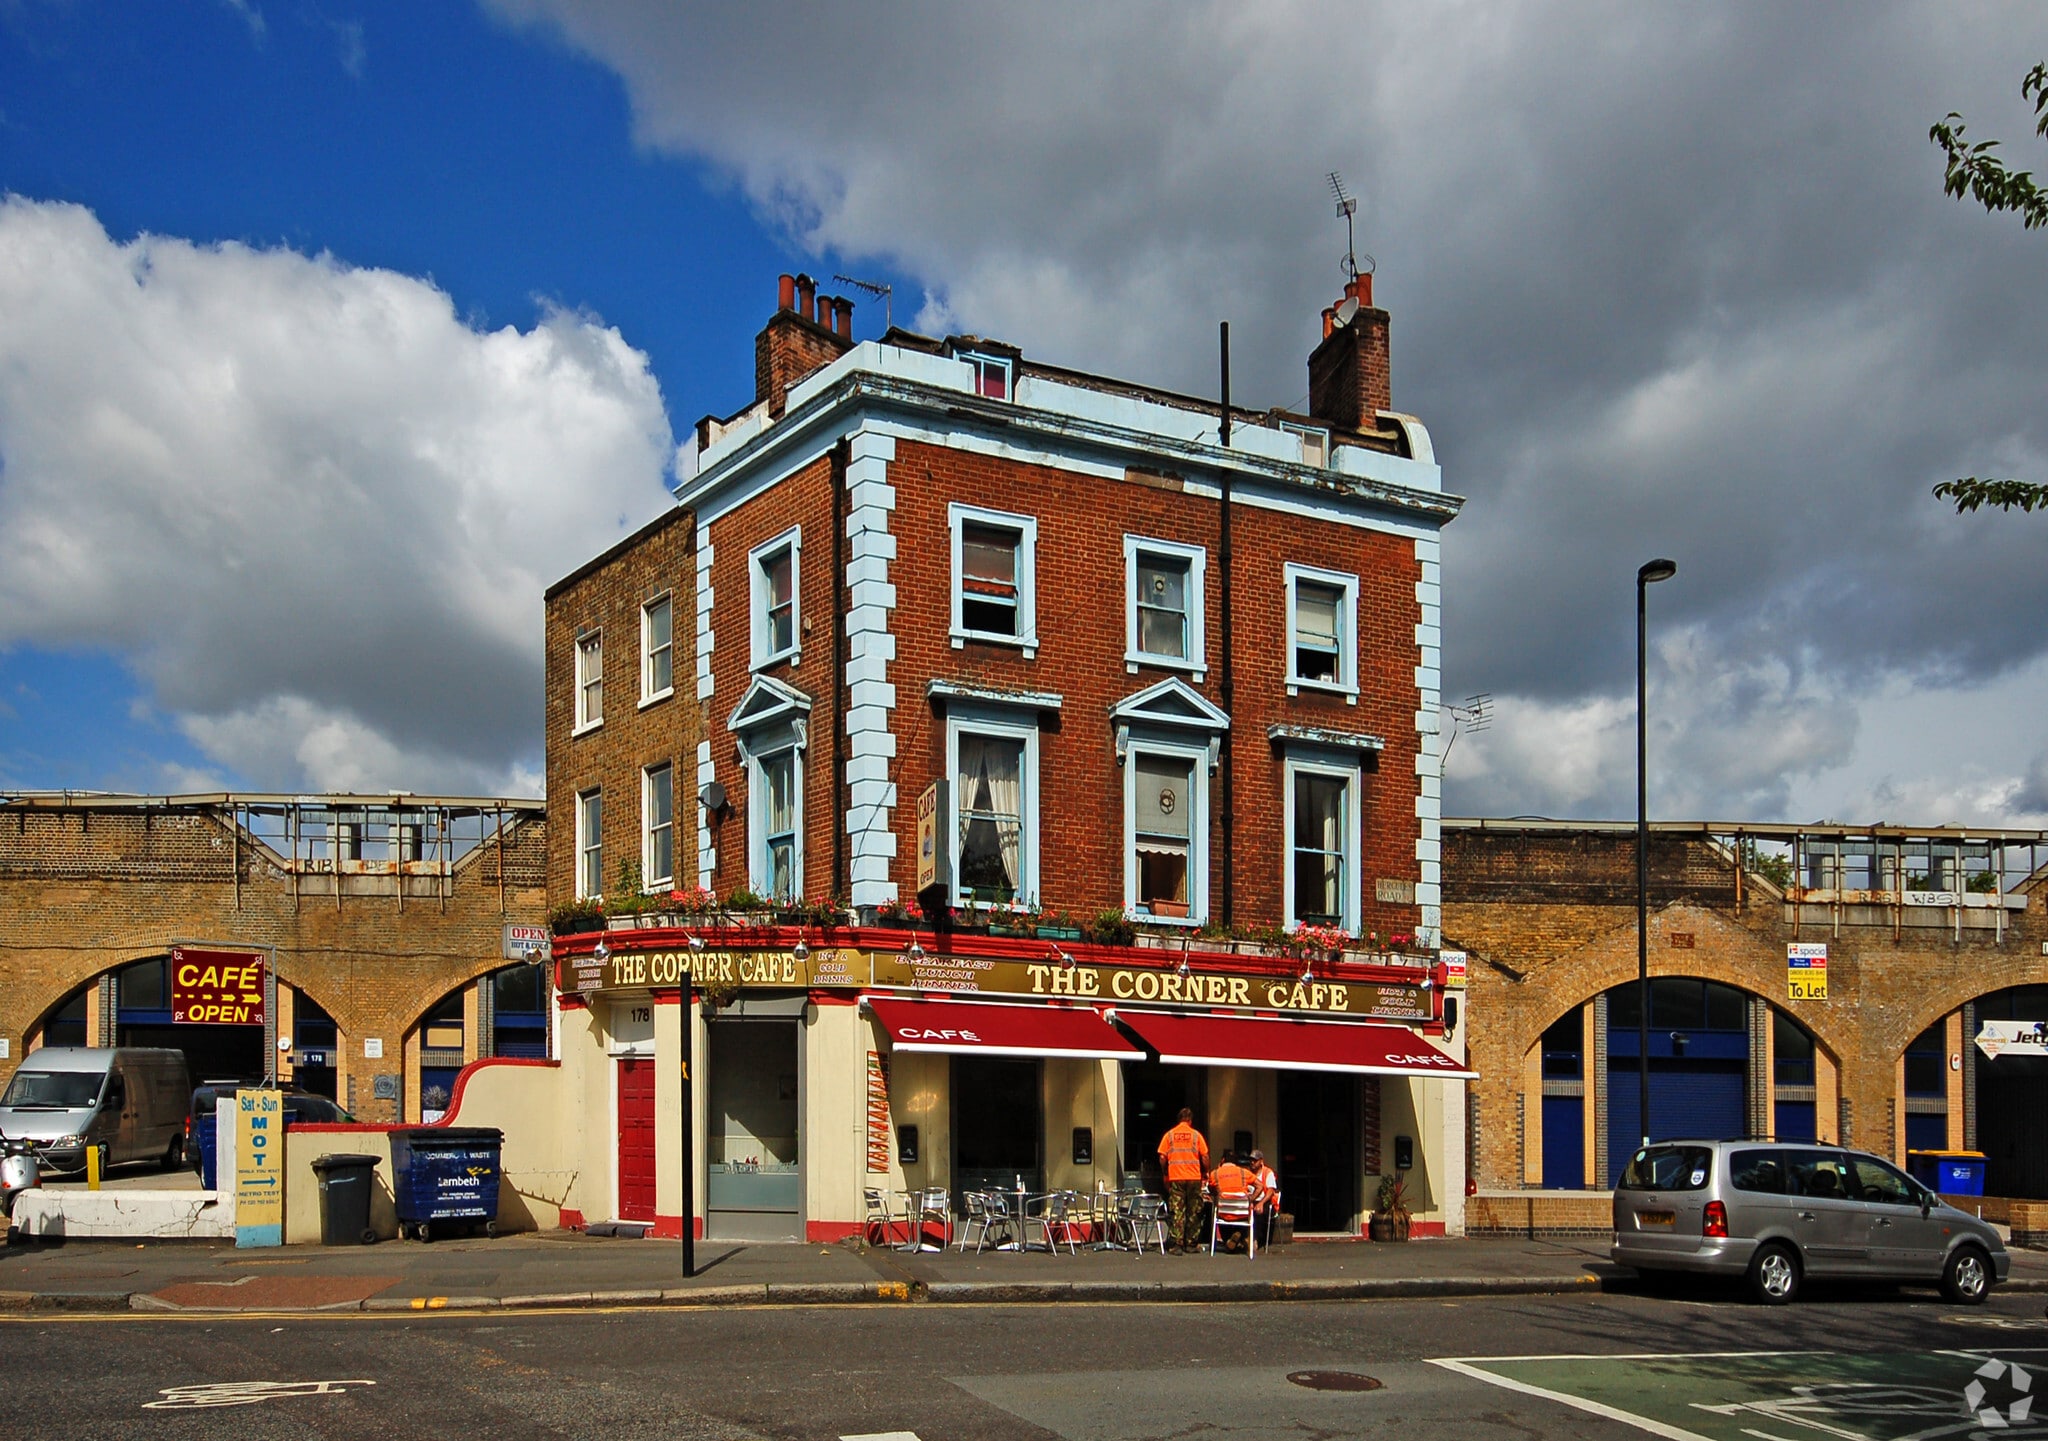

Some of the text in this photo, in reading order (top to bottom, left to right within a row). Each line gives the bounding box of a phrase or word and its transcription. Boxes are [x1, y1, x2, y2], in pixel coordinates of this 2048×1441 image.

[1377, 890, 1402, 900] ROAD
[511, 927, 546, 940] OPEN
[511, 941, 524, 949] HOT
[817, 951, 848, 962] HOT &
[1440, 954, 1465, 964] pacia
[612, 952, 797, 984] THE CORNER CAFE
[819, 962, 847, 973] COLD
[178, 961, 259, 990] CAFÉ
[813, 974, 853, 984] DRINKS
[915, 968, 975, 980] LUNCH
[1026, 964, 1349, 1012] THE CORNER CAFE
[1789, 982, 1826, 998] To Let
[188, 1004, 249, 1022] OPEN
[631, 1008, 650, 1022] 178
[898, 1027, 982, 1042] CAFÉ
[241, 1095, 255, 1112] Sat
[261, 1096, 278, 1112] Sun
[425, 1151, 491, 1160] COMMERCL WASTE
[437, 1175, 480, 1187] Lambeth
